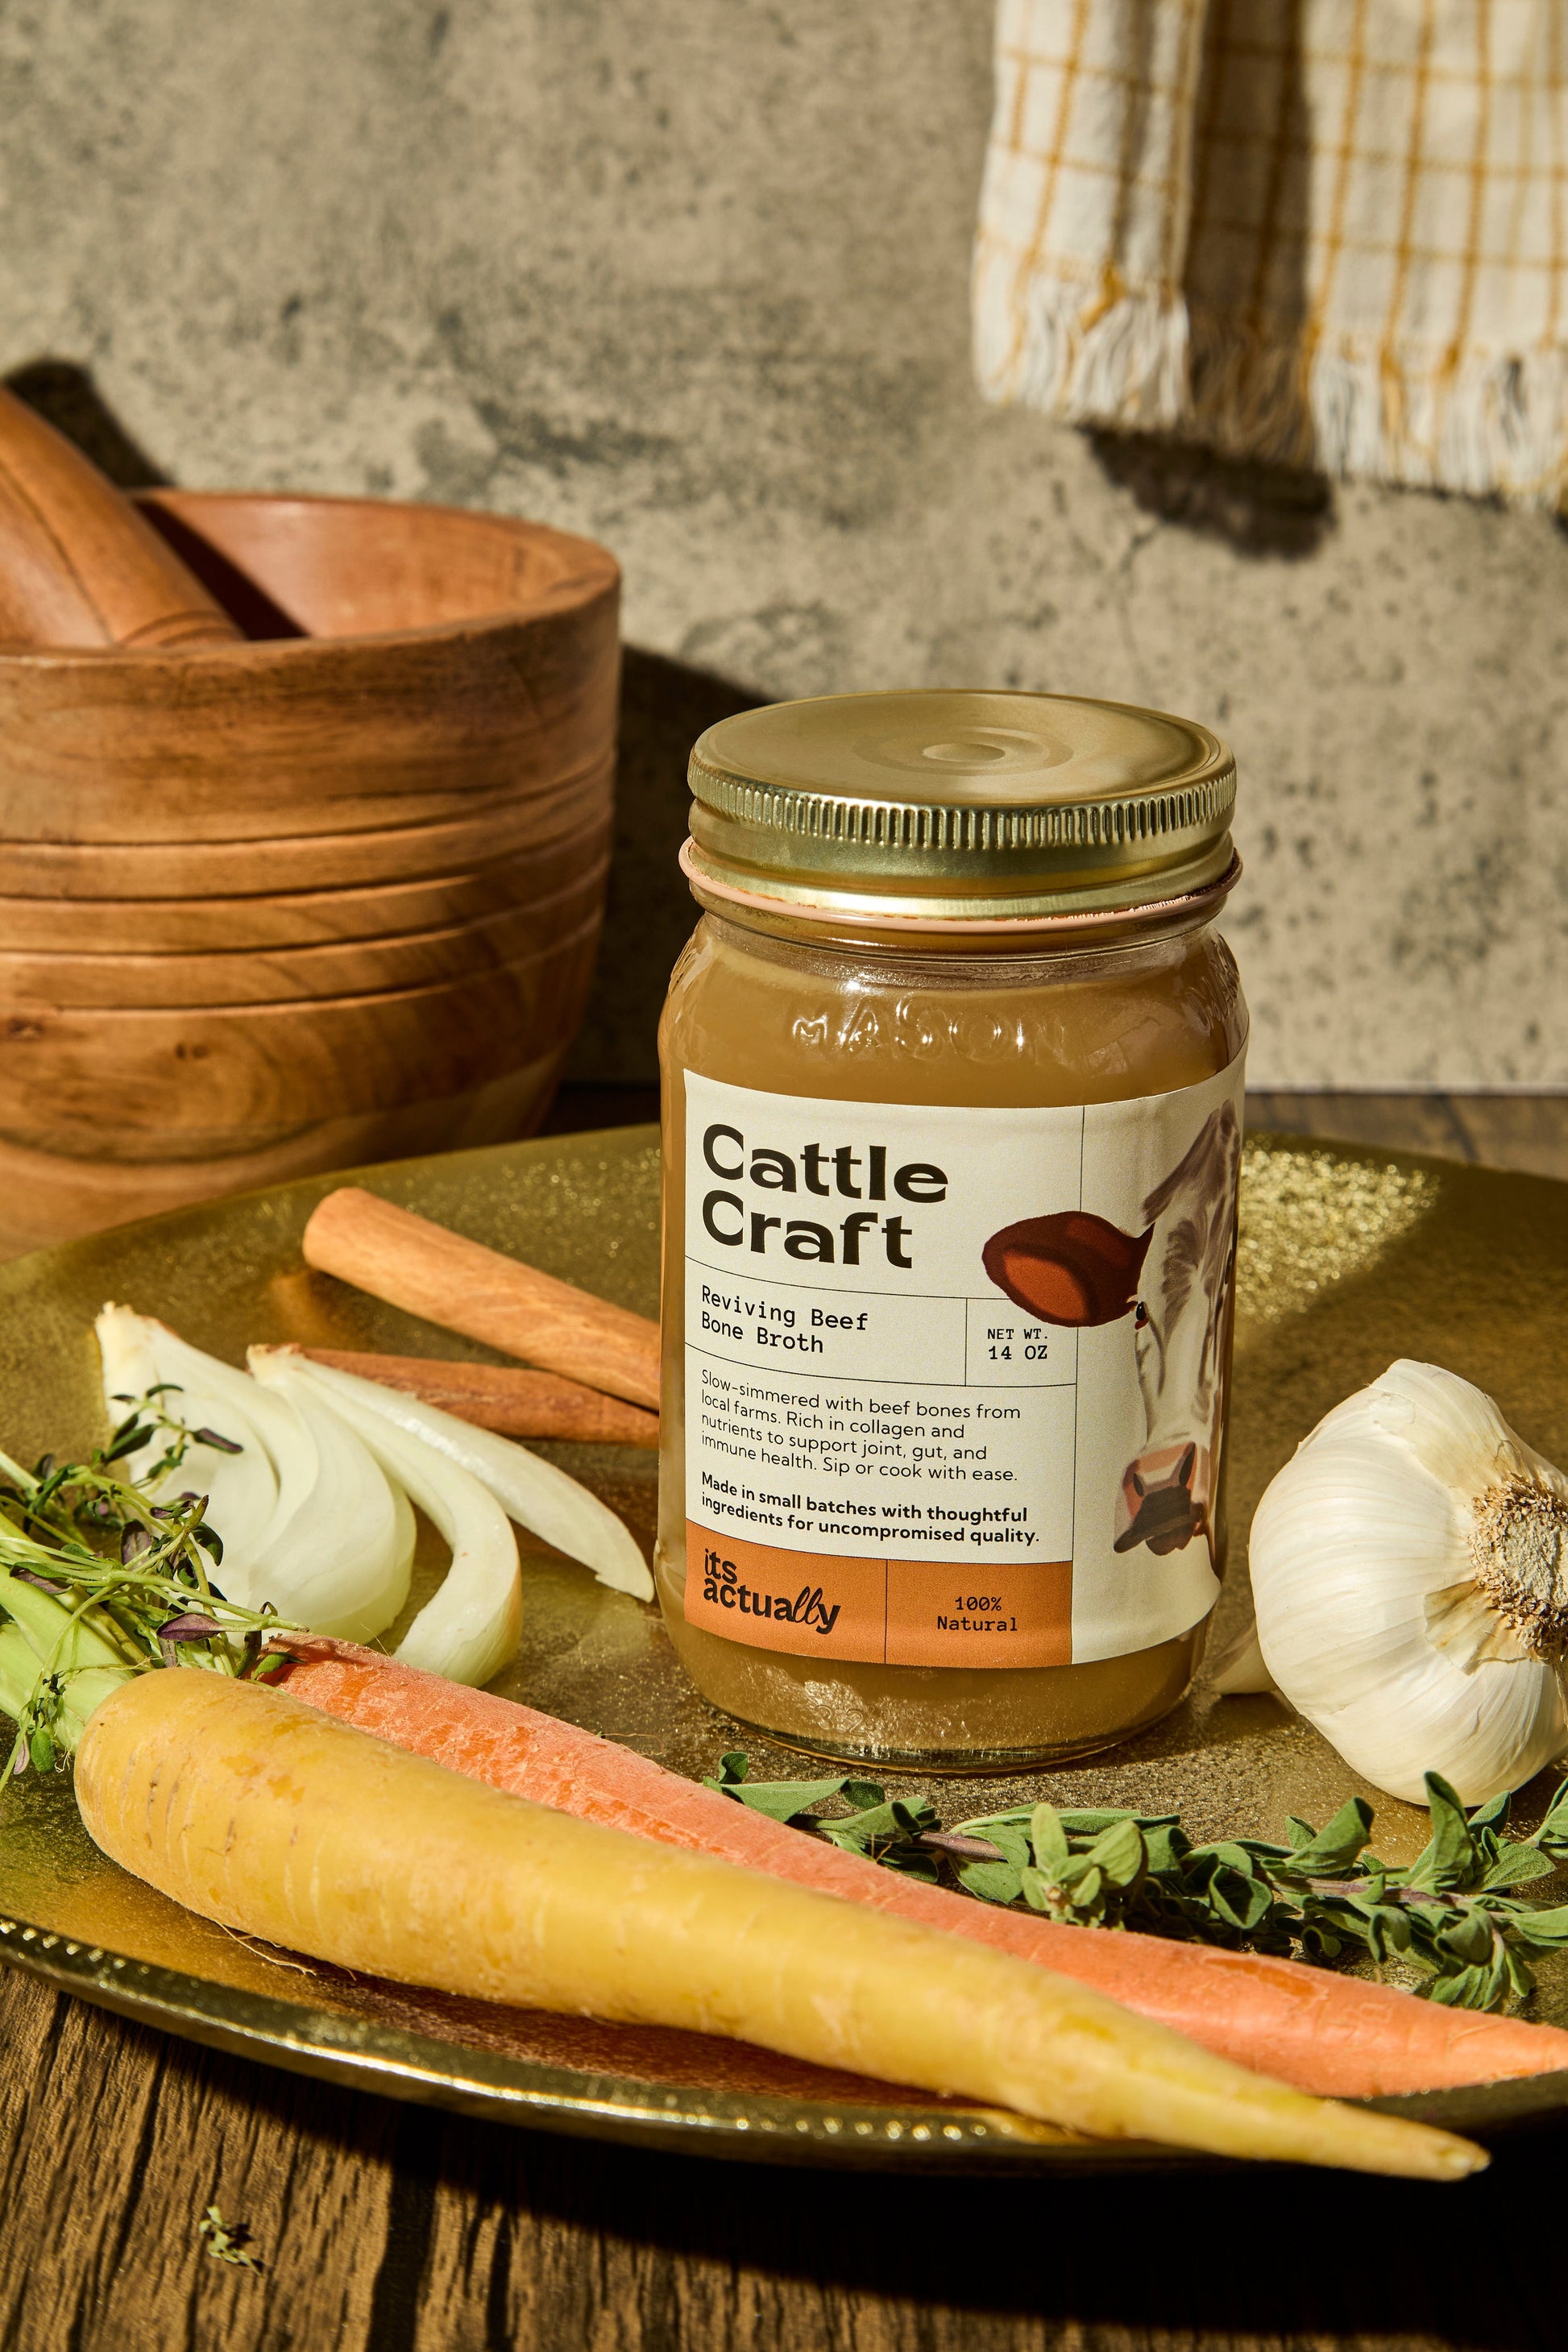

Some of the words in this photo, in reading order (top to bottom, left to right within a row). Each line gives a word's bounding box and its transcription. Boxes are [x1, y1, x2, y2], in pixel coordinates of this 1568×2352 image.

[703, 1123, 948, 1203] Cattle
[703, 1190, 913, 1268] Craft
[702, 1285, 795, 1328] Reviving
[811, 1309, 868, 1330] Beef
[703, 1311, 743, 1339] Bone
[757, 1326, 823, 1353] Broth
[988, 1329, 1014, 1339] NET
[1023, 1329, 1047, 1339] WT.
[989, 1346, 1011, 1359] 14
[1025, 1345, 1047, 1360] OZ
[702, 1370, 819, 1407] Slow-simmered
[826, 1396, 862, 1412] with
[870, 1399, 911, 1415] beef
[917, 1401, 970, 1417] bones
[977, 1404, 1020, 1418] from
[702, 1389, 730, 1412] local
[734, 1400, 780, 1424] farms.
[787, 1411, 823, 1429] Rich
[830, 1416, 844, 1431] in
[850, 1419, 924, 1439] collagen
[931, 1425, 964, 1438] and
[702, 1411, 762, 1443] nutrients
[768, 1431, 783, 1445] to
[790, 1437, 857, 1454] support
[861, 1440, 906, 1458] joint,
[913, 1446, 946, 1462] gut,
[953, 1446, 986, 1459] and
[702, 1430, 756, 1459] immune
[761, 1448, 816, 1470] health.
[823, 1457, 849, 1476] Sip
[856, 1464, 874, 1475] or
[880, 1464, 922, 1478] cook
[928, 1465, 965, 1479] with
[973, 1471, 1017, 1480] ease.
[702, 1491, 782, 1527] ingredients
[787, 1515, 814, 1530] for
[819, 1523, 964, 1541] uncompromised
[970, 1528, 1039, 1546] quality.
[703, 1471, 737, 1495] Made
[742, 1484, 754, 1500] in
[759, 1489, 801, 1509] small
[807, 1496, 876, 1516] batches
[881, 1504, 921, 1519] with
[927, 1506, 1027, 1524] thoughtful
[705, 1549, 737, 1584] its
[703, 1578, 841, 1634] actually
[938, 1616, 1018, 1632] Natural
[955, 1596, 1002, 1611] 100%
